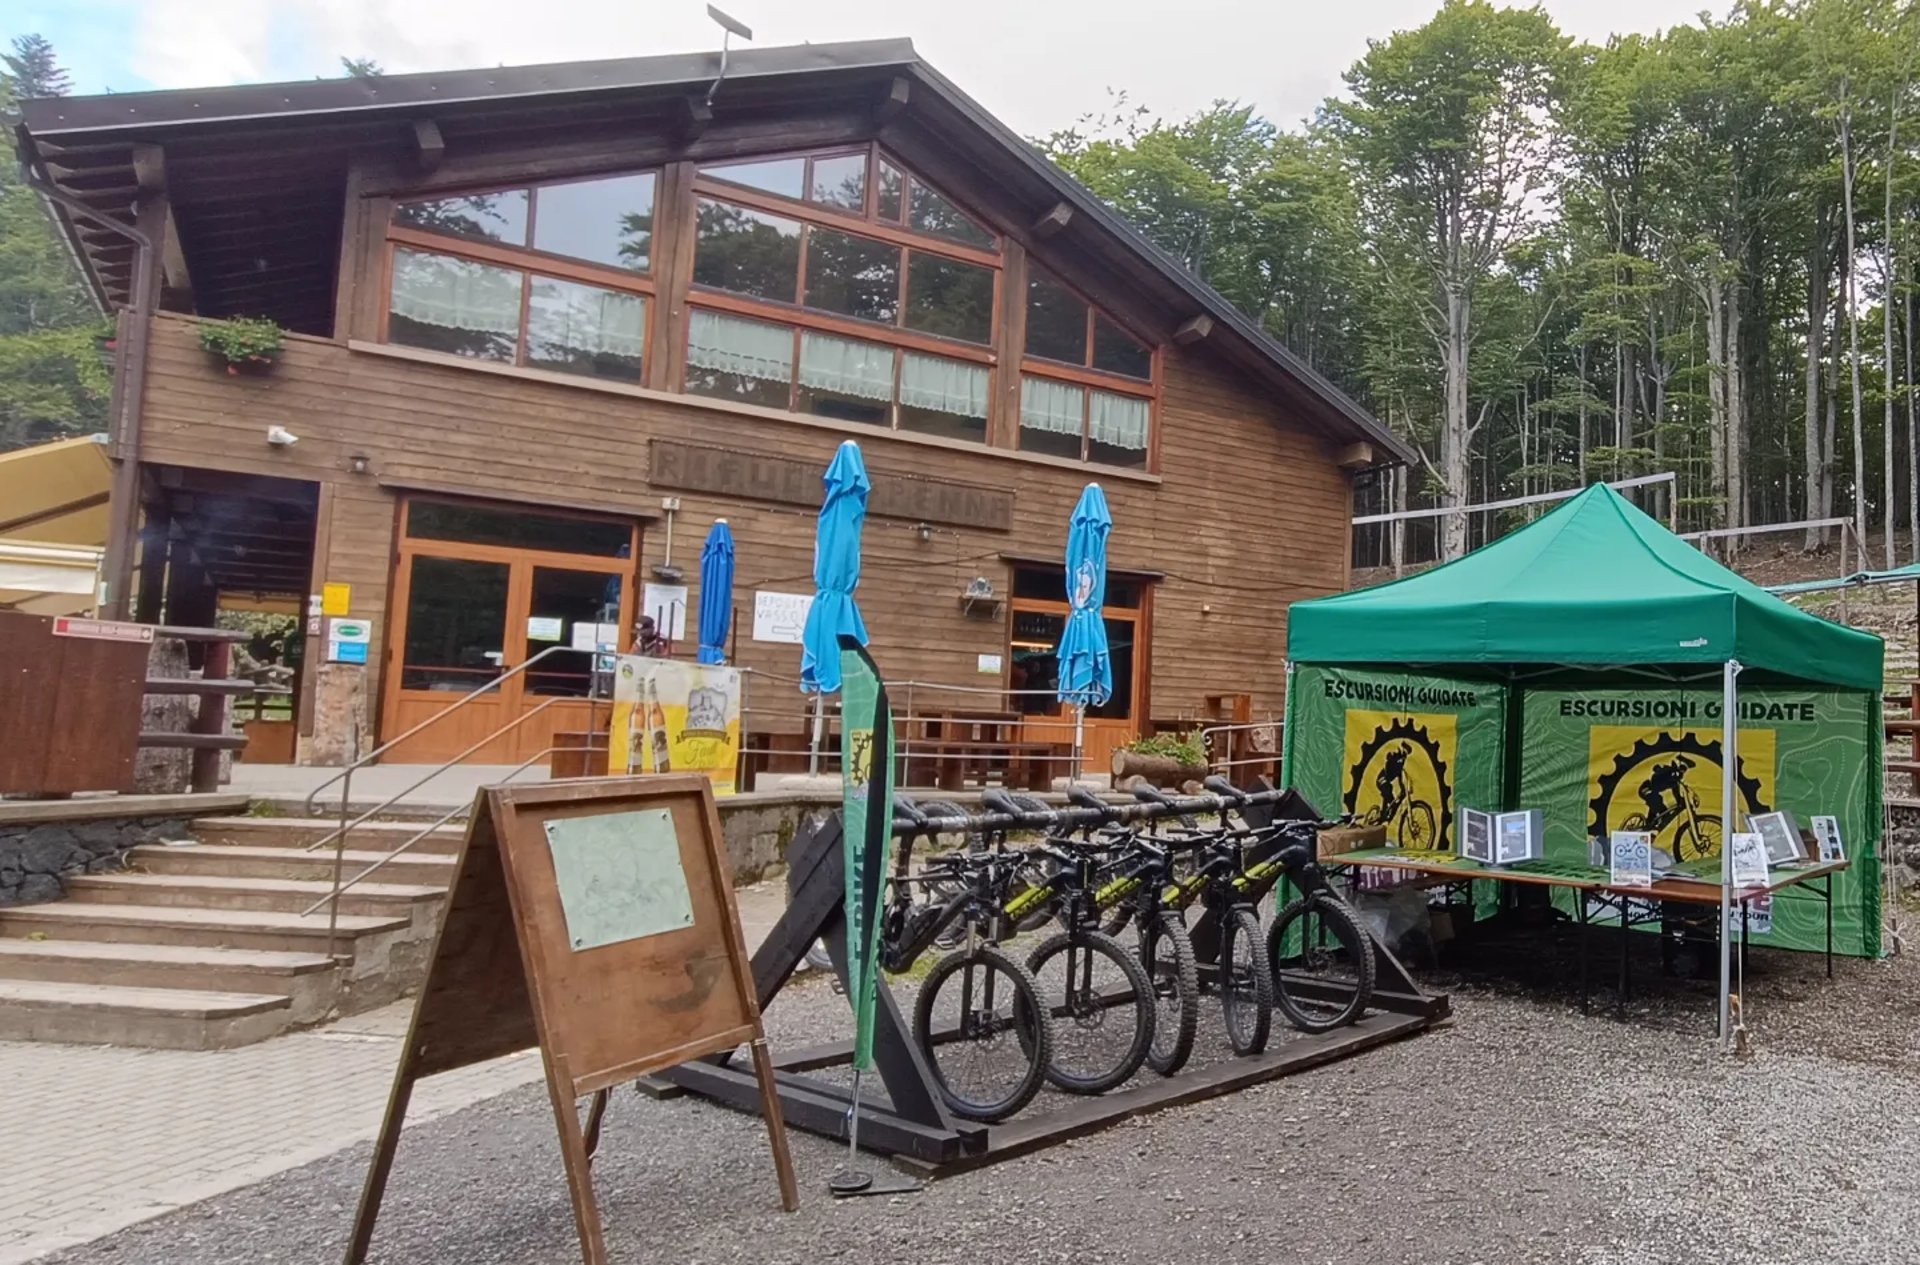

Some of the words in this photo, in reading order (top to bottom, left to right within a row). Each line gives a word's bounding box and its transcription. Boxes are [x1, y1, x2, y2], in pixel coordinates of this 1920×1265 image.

[757, 595, 810, 610] DEPOSIT
[1324, 679, 1414, 704] ESCURSIONI
[1417, 687, 1477, 707] GUIDATE
[1559, 699, 1696, 718] ESCURSIONI
